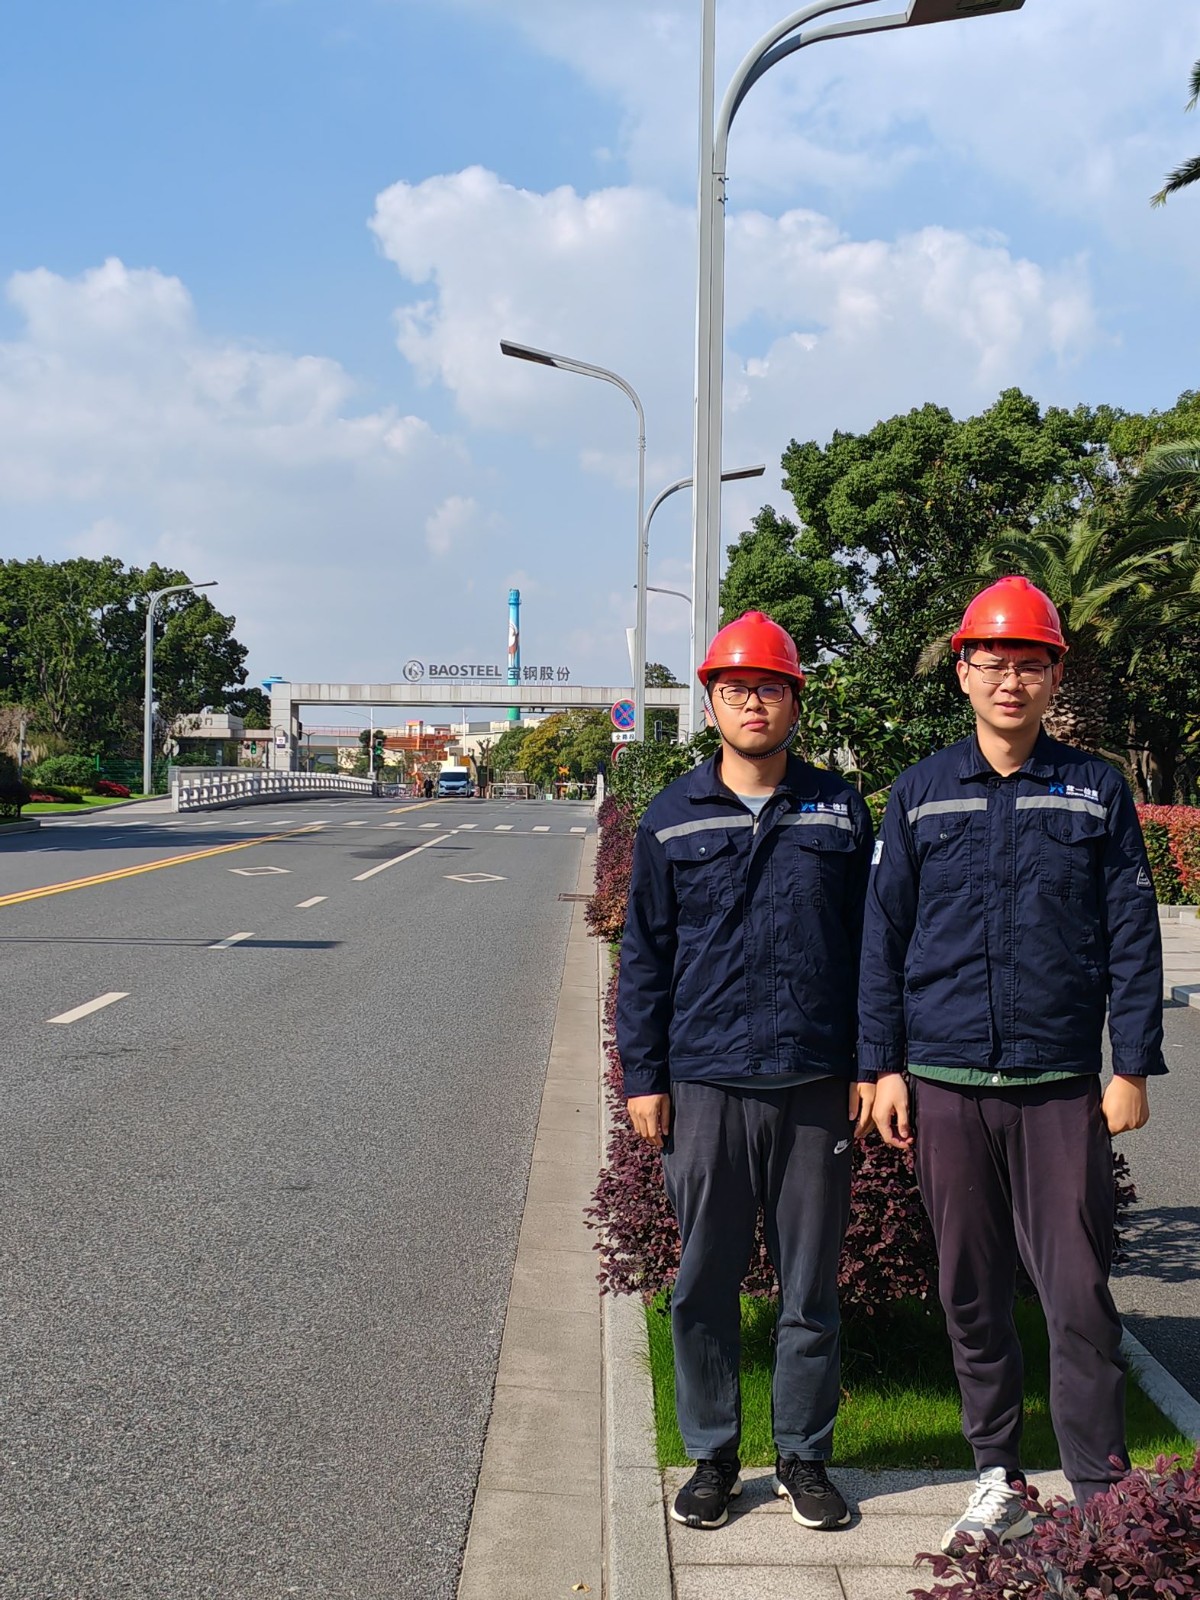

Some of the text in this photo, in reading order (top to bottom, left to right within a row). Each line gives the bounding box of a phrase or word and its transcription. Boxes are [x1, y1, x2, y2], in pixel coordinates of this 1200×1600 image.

[428, 664, 502, 676] BAOSTEEL
[507, 666, 570, 681] 宝钢股份
